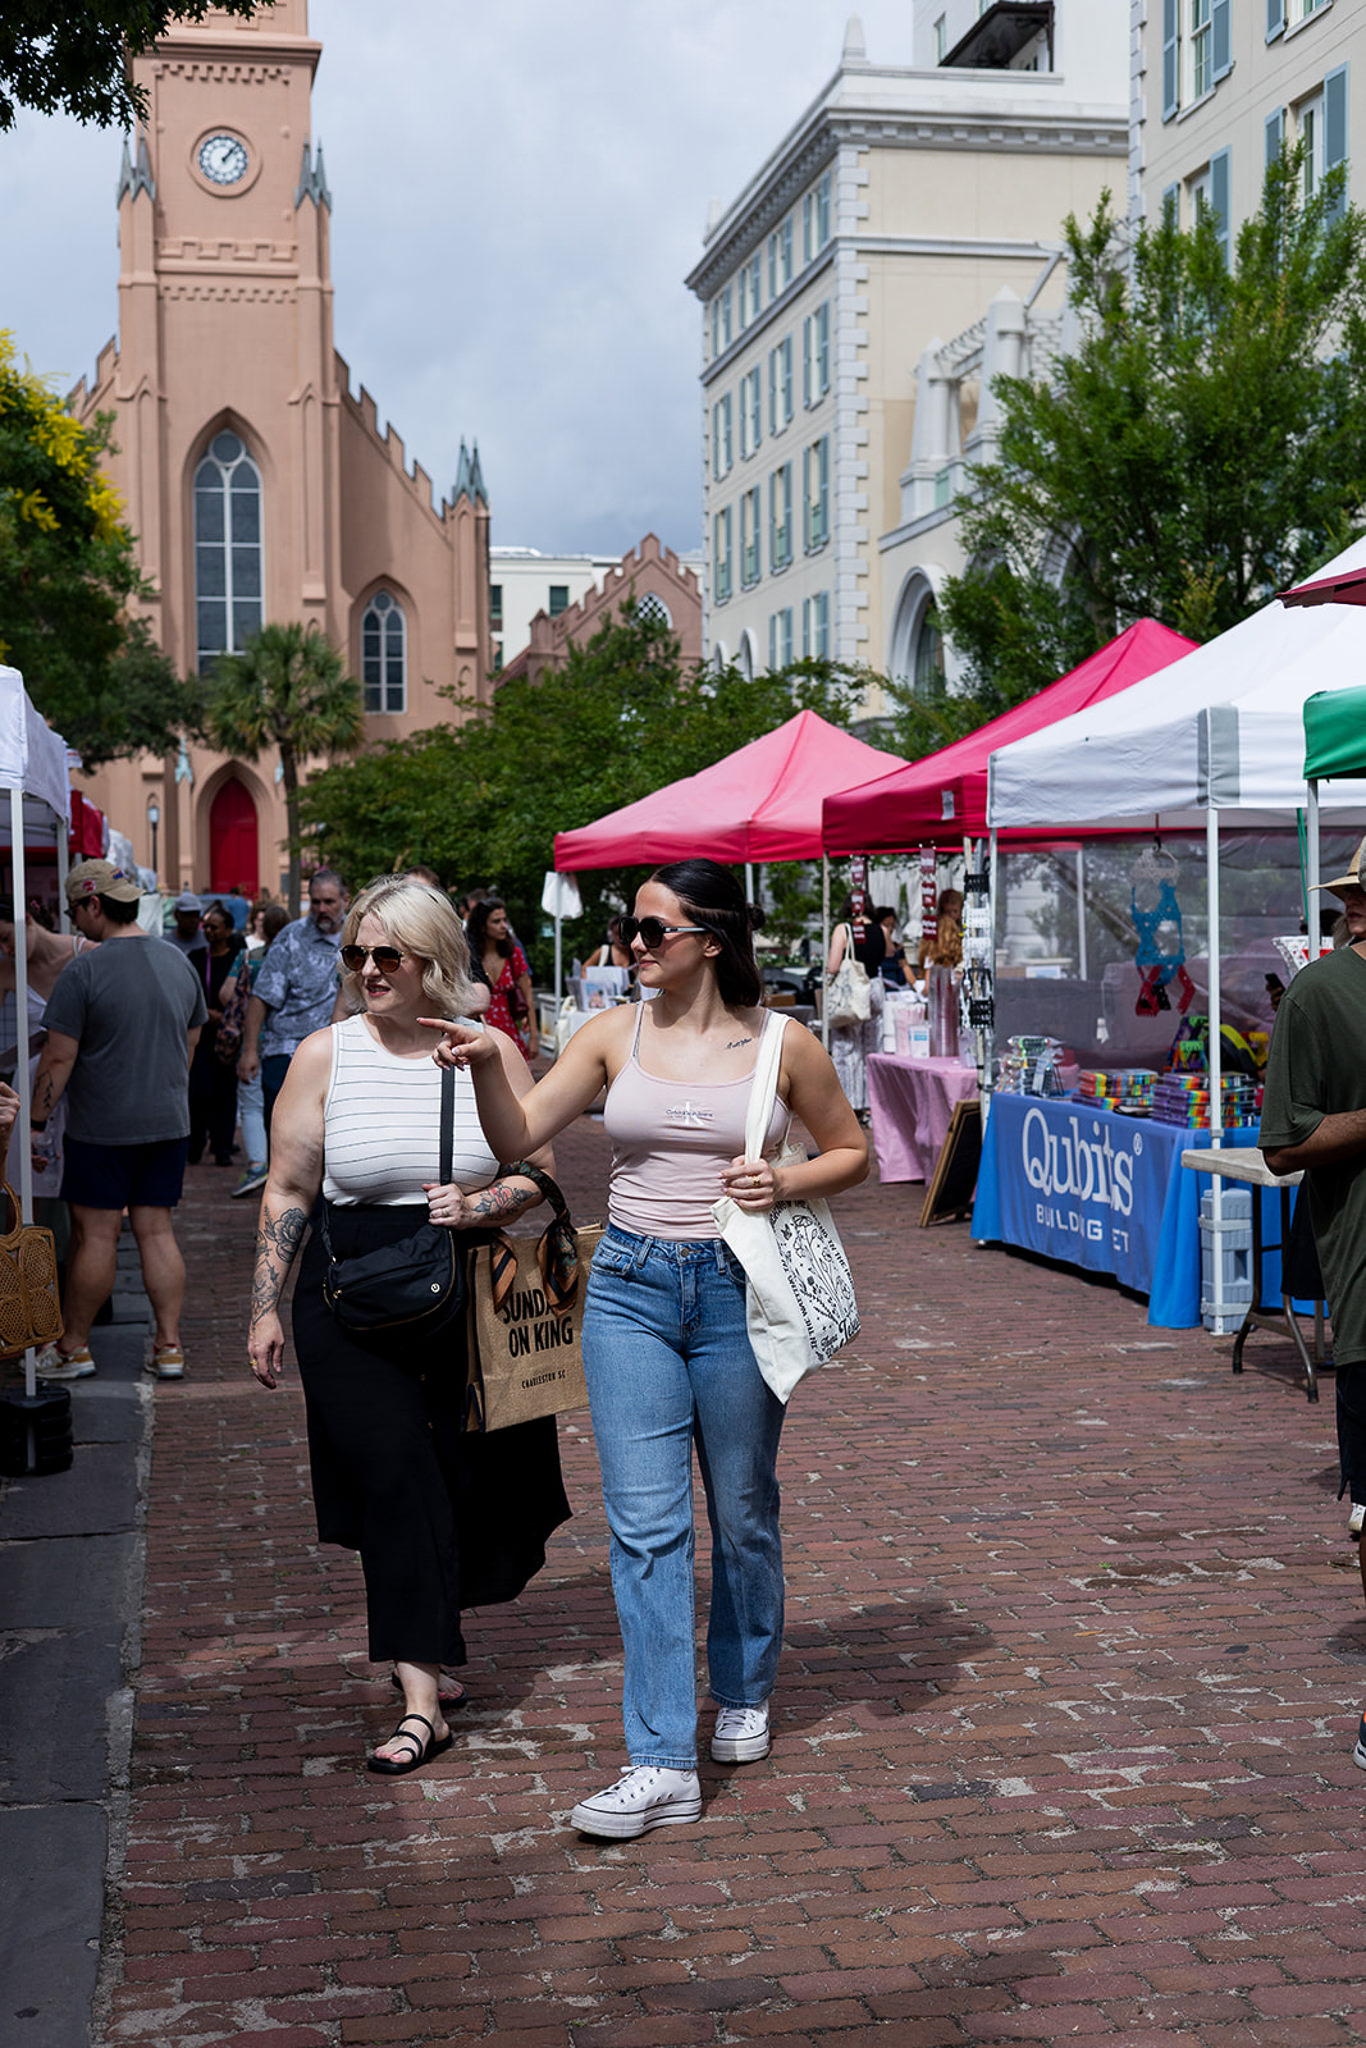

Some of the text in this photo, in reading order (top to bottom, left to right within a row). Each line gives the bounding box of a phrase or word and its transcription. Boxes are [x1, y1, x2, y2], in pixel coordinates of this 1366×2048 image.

[1036, 1203, 1129, 1253] BUILDG ET
[508, 1316, 574, 1358] ON KING
[521, 1369, 566, 1390] CHARLESTON SC
